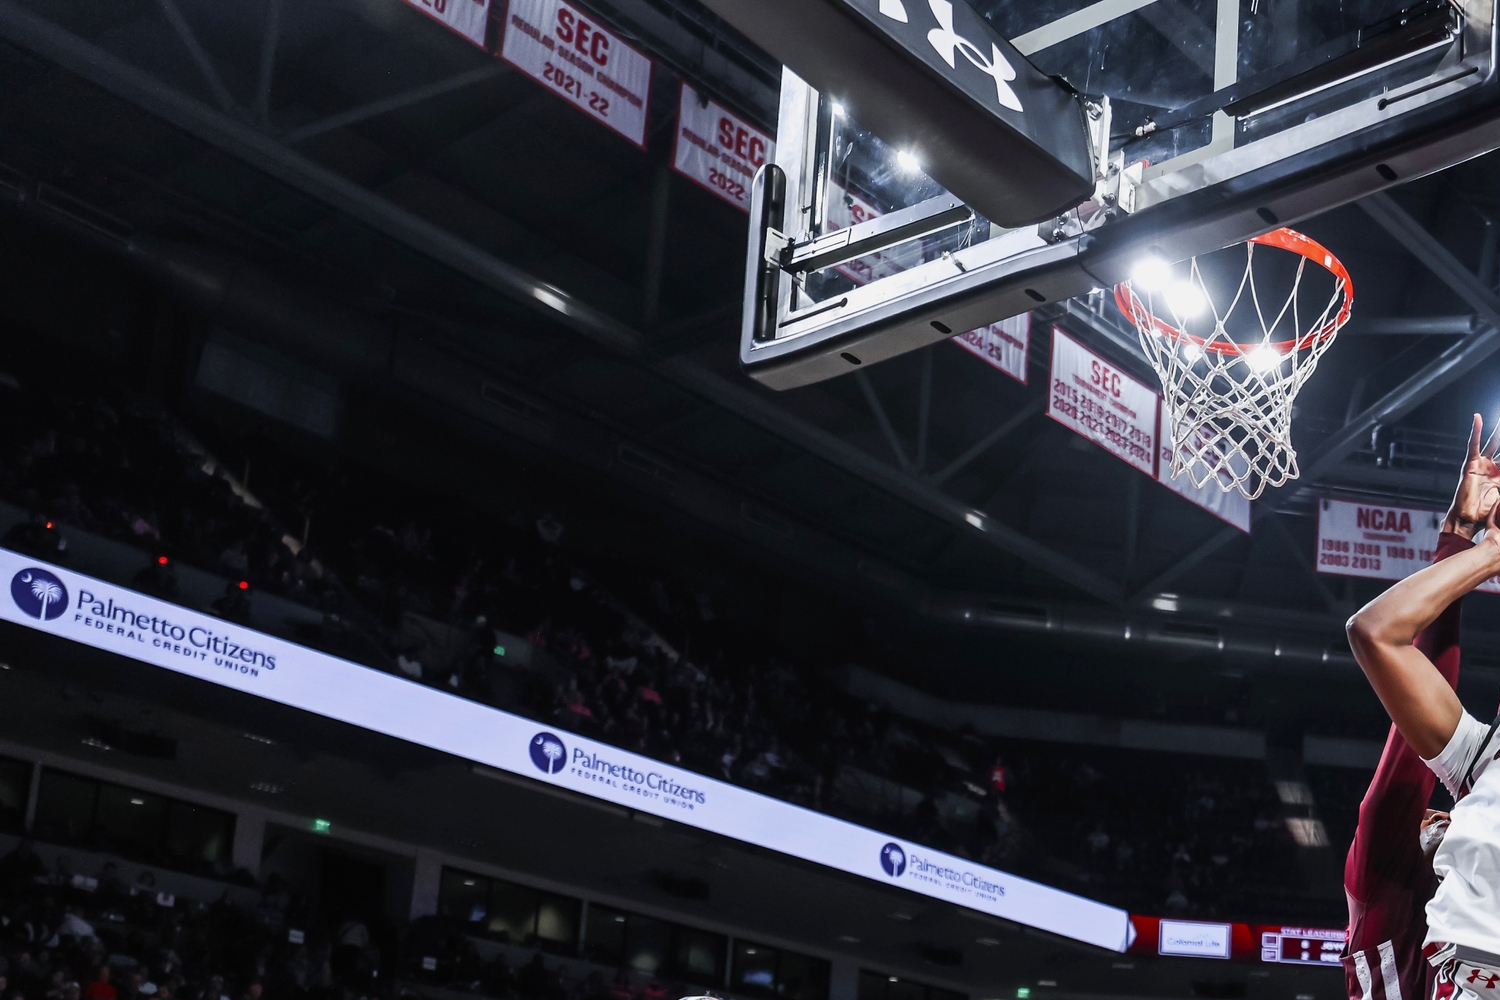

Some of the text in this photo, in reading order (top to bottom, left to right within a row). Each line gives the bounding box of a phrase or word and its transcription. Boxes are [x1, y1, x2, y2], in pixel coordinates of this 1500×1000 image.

[556, 8, 609, 66] SEC
[543, 61, 609, 117] 2021-22
[719, 117, 764, 168] SEC
[1091, 360, 1121, 398] SEC
[1356, 507, 1413, 533] NCAA
[1320, 553, 1381, 571] 2003 2013
[75, 613, 259, 678] FEDERAL CREDIT UNION
[77, 589, 277, 671] Palmetto Citizens
[572, 747, 706, 805] Palmetto Citizens
[910, 854, 1006, 897] Palmetto Citizens
